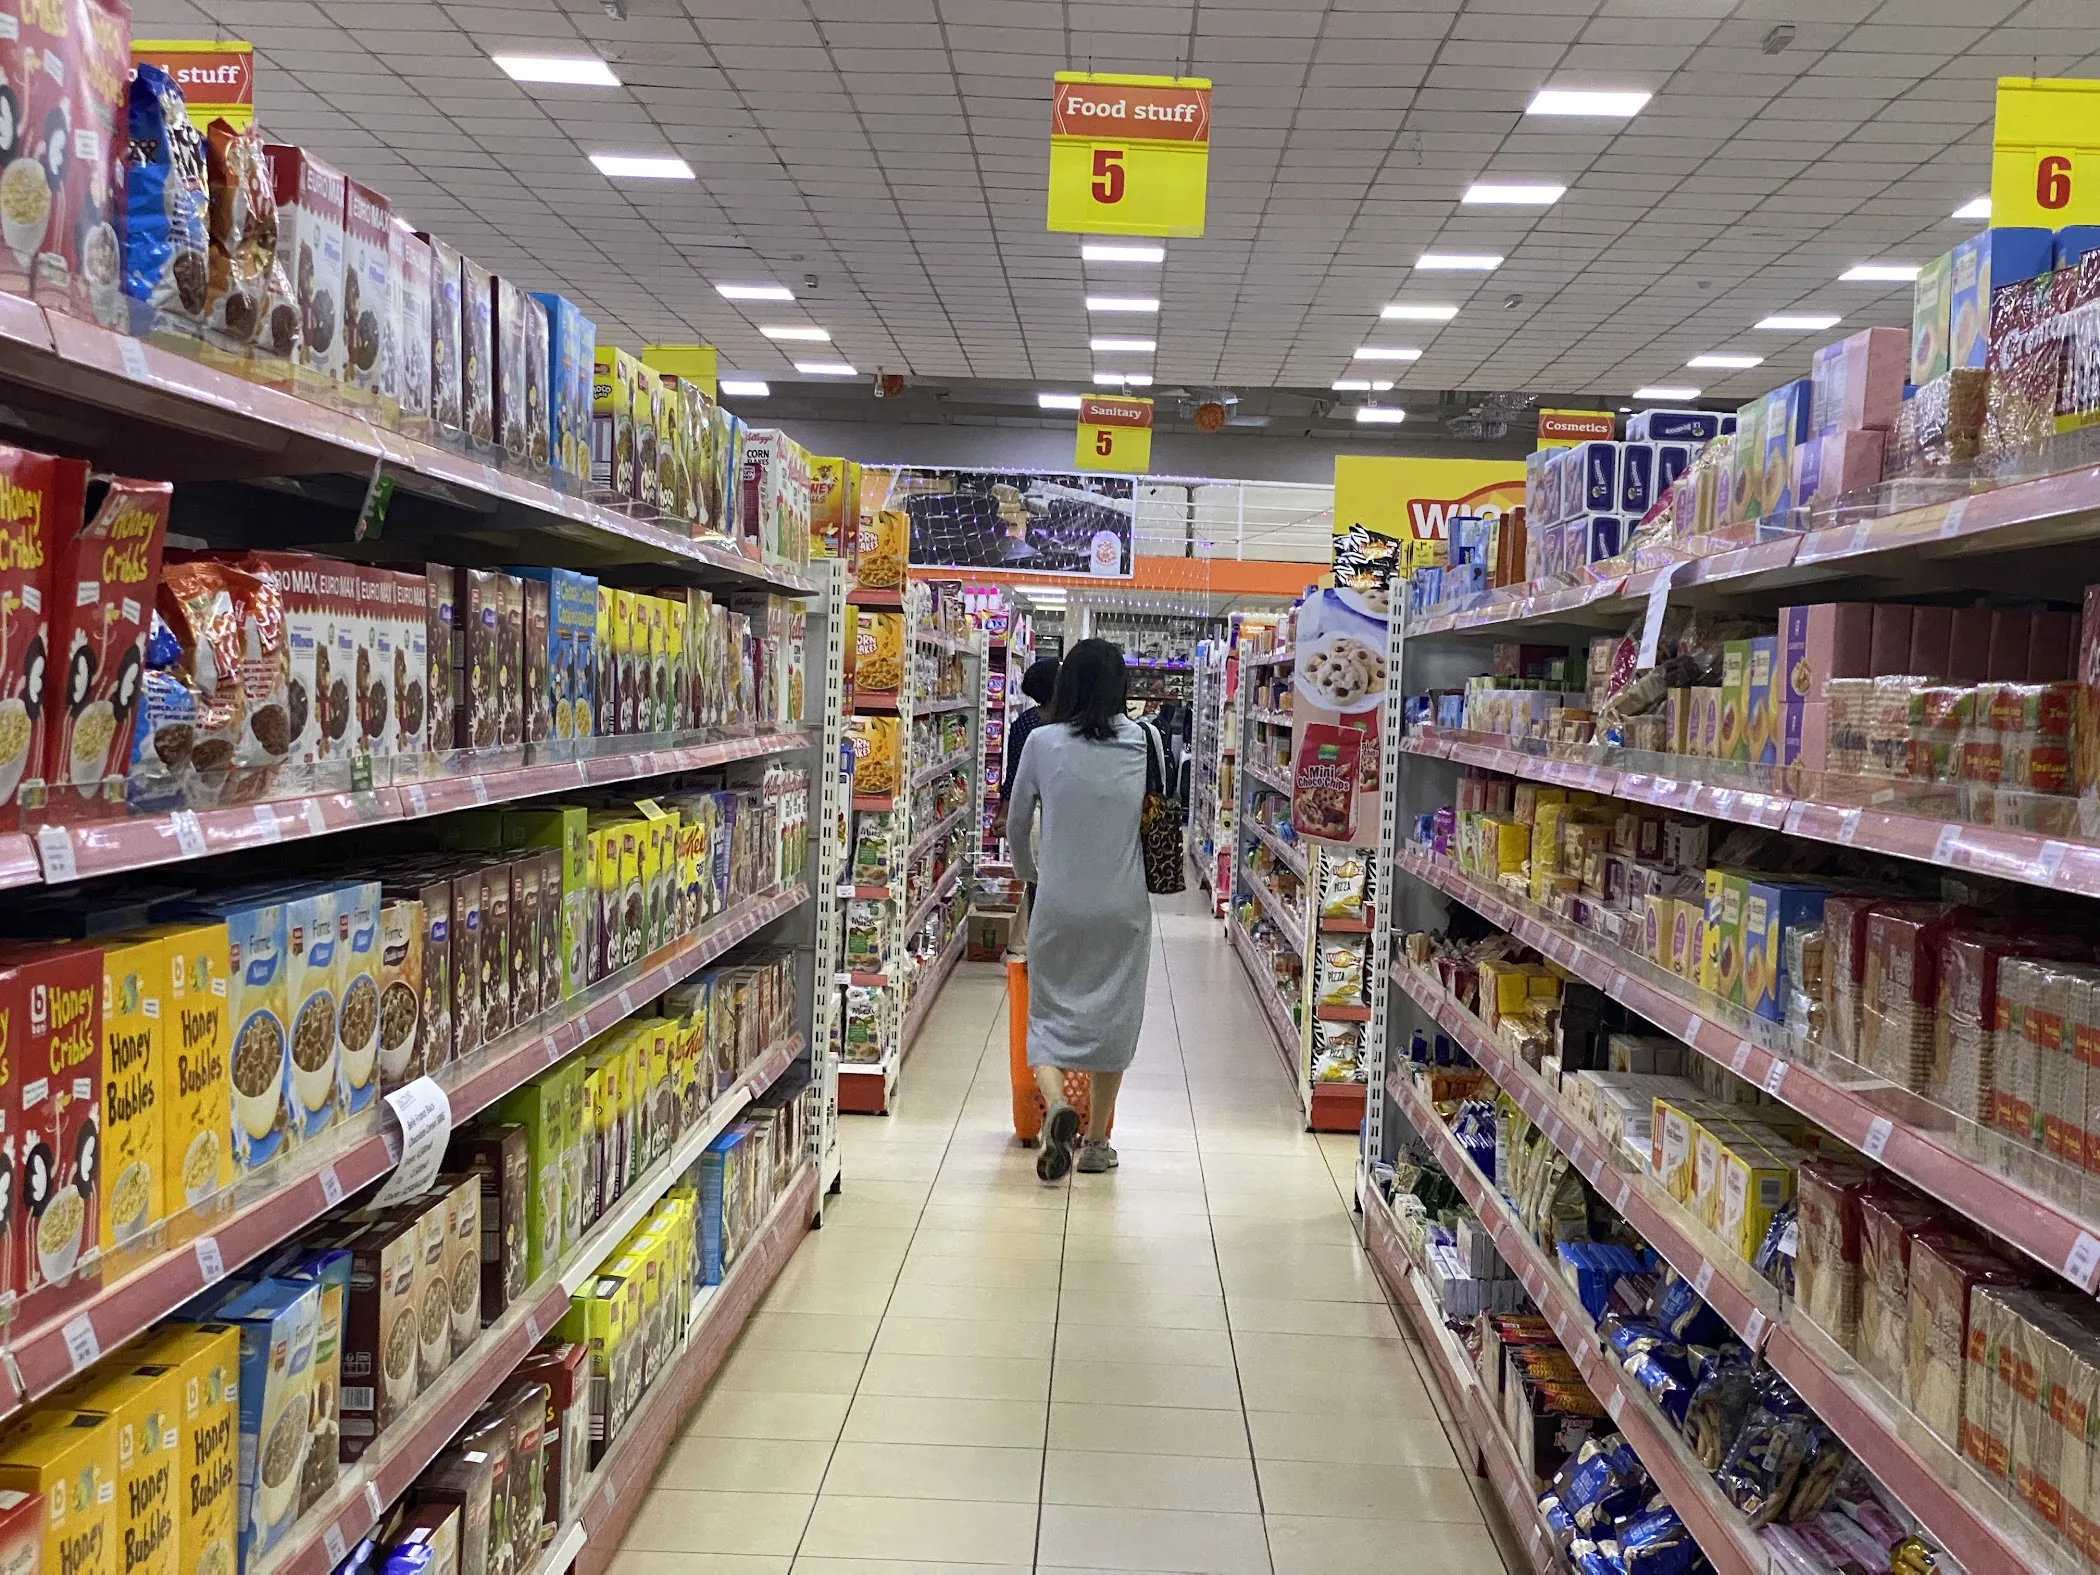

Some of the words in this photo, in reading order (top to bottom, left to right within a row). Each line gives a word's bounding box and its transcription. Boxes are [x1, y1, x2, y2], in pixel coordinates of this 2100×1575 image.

[177, 65, 241, 84] stuff
[1066, 96, 1126, 119] Food
[1134, 103, 1198, 124] stuff
[1092, 150, 1125, 204] 5
[2036, 155, 2072, 210] 6
[1090, 405, 1142, 420] Sanitary
[1545, 420, 1608, 433] Cosmetics
[746, 450, 769, 458] CORN
[1095, 430, 1112, 457] 5
[811, 484, 834, 494] NEY
[859, 532, 878, 543] ORN
[103, 542, 148, 584] Cribbs
[857, 636, 877, 646] ORN
[853, 738, 871, 748] ORN
[1309, 765, 1335, 779] Mini
[1334, 881, 1351, 892] PIZZA
[1328, 971, 1345, 983] PIZZA
[50, 984, 94, 1029] Honey
[181, 1006, 219, 1048] Honey
[50, 1019, 94, 1075] Cribbs
[109, 1028, 151, 1074] Honey
[178, 1047, 223, 1098] Bubbles
[107, 1072, 155, 1127] Bubbles
[194, 1413, 232, 1466] Honey
[129, 1459, 170, 1520] Honey
[191, 1456, 234, 1517] Bubbles
[60, 1515, 104, 1575] Honey
[124, 1508, 172, 1575] Bubbles
